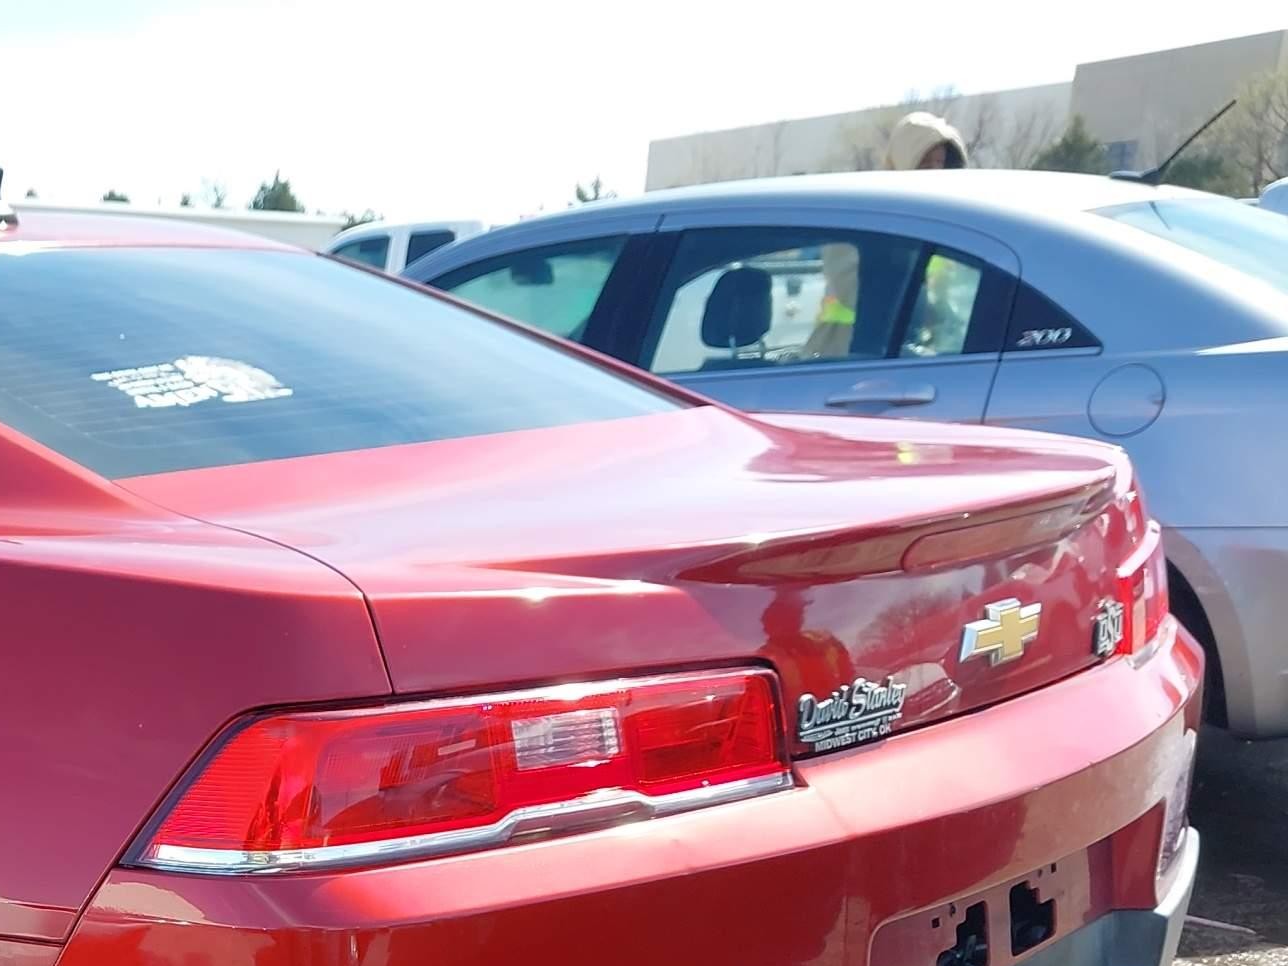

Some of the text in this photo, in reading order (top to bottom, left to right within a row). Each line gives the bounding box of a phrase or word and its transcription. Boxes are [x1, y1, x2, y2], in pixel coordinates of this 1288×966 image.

[1016, 328, 1072, 346] 200
[799, 684, 850, 729] David
[849, 675, 906, 719] Stanley
[815, 731, 858, 752] MIDWEST
[879, 723, 892, 735] OK
